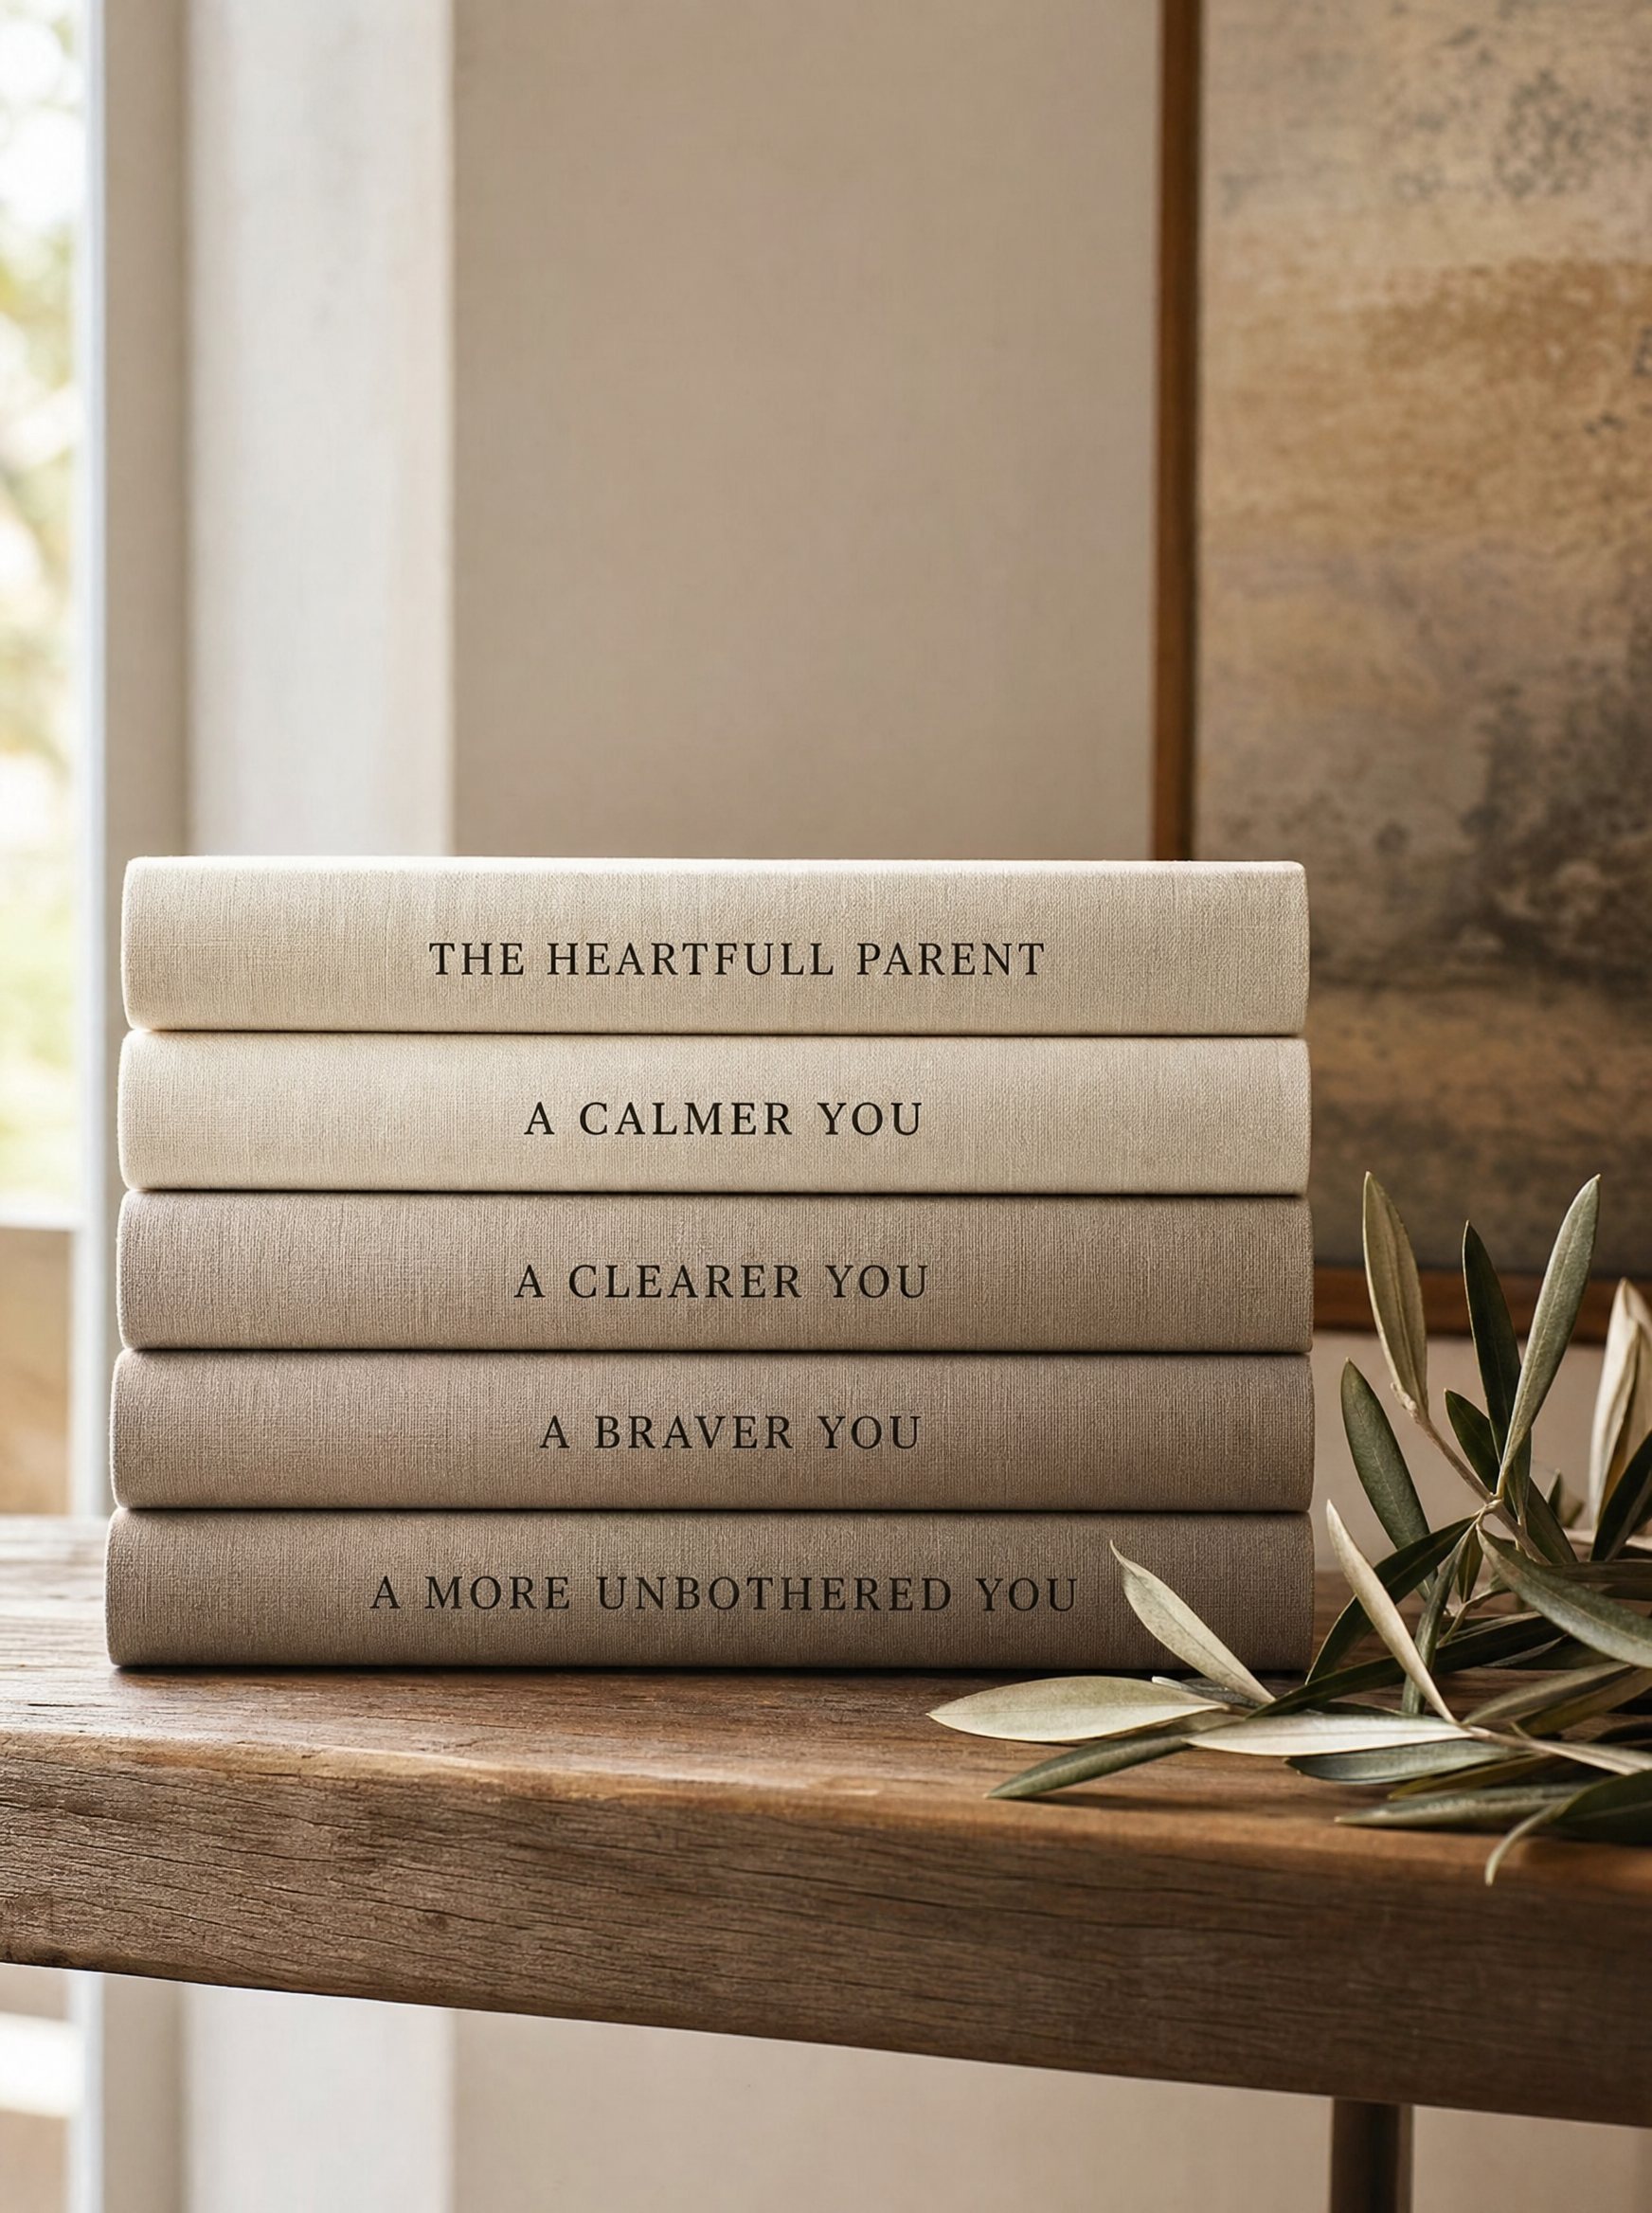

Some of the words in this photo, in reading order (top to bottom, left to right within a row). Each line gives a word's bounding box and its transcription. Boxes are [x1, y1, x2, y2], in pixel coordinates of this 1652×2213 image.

[429, 943, 524, 976] THE
[548, 943, 835, 976] HEARTFULL
[857, 943, 1045, 976] PARENT
[524, 1102, 554, 1135] A
[579, 1101, 792, 1135] CALMER
[817, 1102, 923, 1136] YOU
[514, 1265, 545, 1298] A
[568, 1265, 801, 1298] CLEARER
[825, 1265, 928, 1299] YOU
[540, 1415, 569, 1448] A
[595, 1415, 794, 1448] BRAVER
[817, 1415, 921, 1449] YOU
[370, 1576, 401, 1609] A
[425, 1575, 570, 1610] MORE
[597, 1576, 952, 1611] UNBOTHERED
[976, 1577, 1081, 1612] YOU
